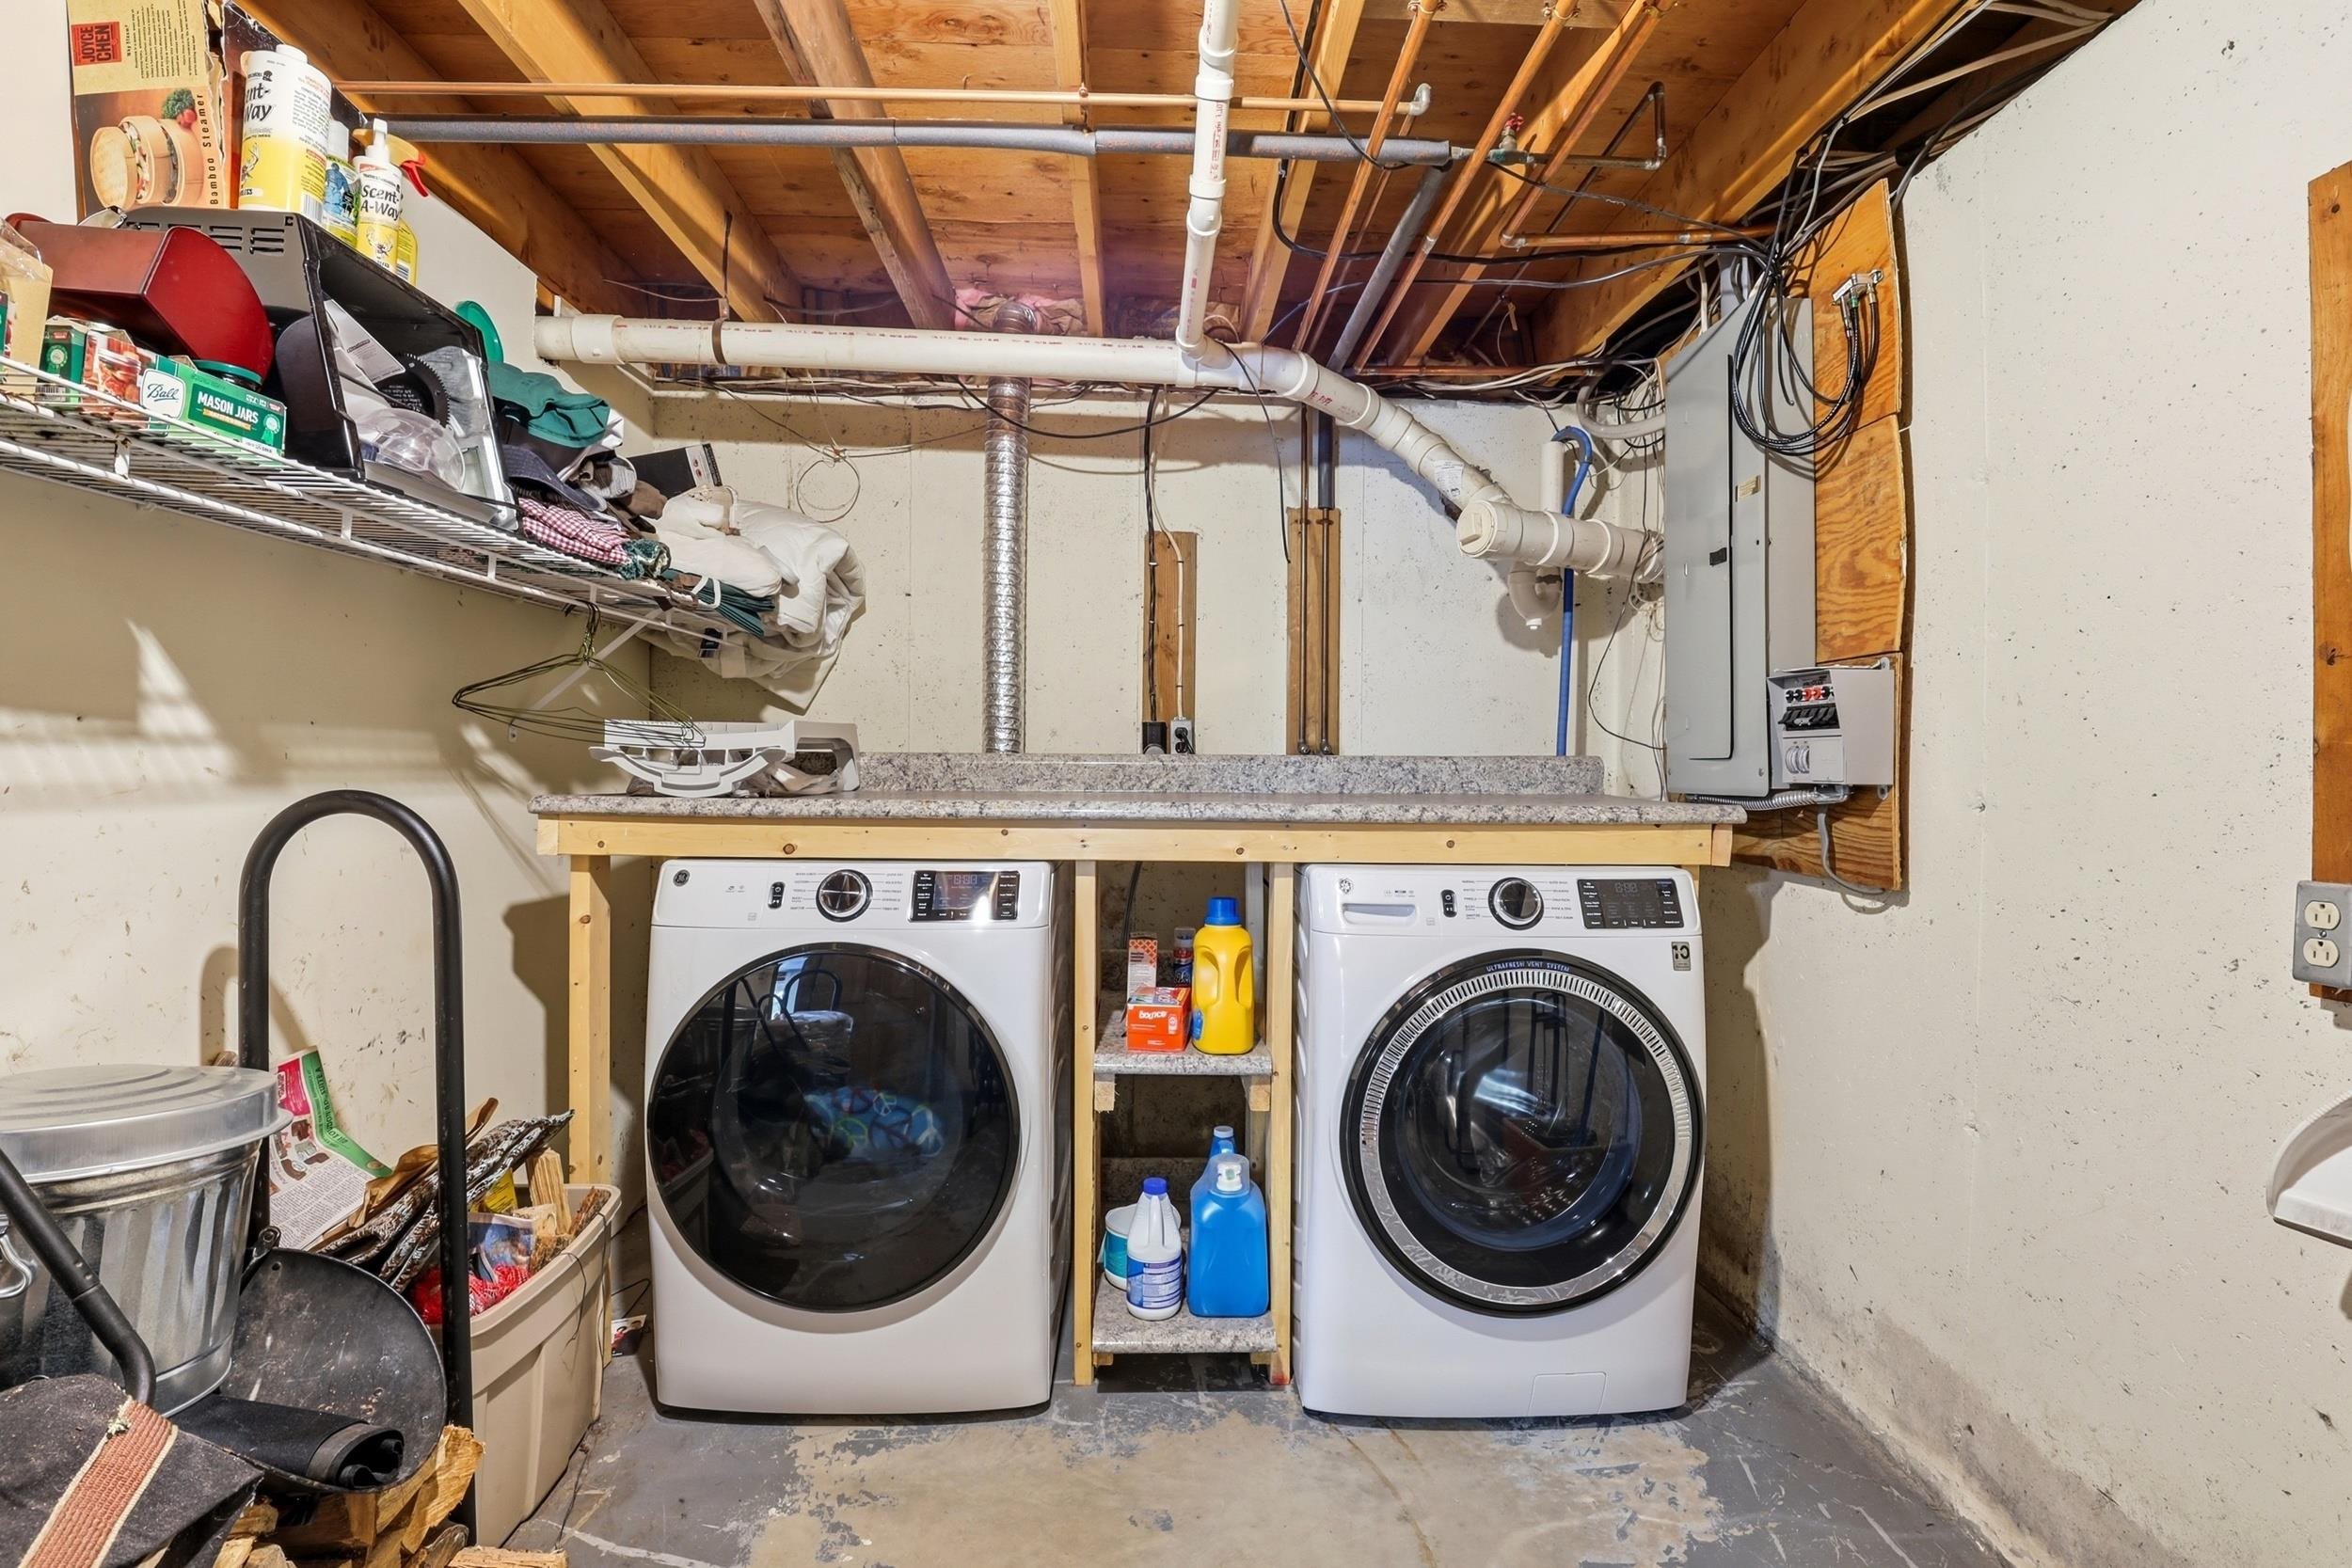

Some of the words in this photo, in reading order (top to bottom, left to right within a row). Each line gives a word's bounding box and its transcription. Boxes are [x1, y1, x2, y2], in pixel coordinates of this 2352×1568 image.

[80, 26, 97, 62] JOYCE
[95, 24, 112, 62] CHEN
[196, 93, 212, 148] Steamer
[206, 157, 219, 205] Bamboo
[361, 184, 400, 204] Scent-
[360, 199, 401, 221] A-Way
[147, 383, 180, 402] Ball
[197, 391, 234, 416] MASON
[234, 405, 260, 424] JARS
[1486, 961, 1524, 972] ULTRAFRESH
[1527, 960, 1543, 969] VENT
[1547, 962, 1571, 972] SYSTEM
